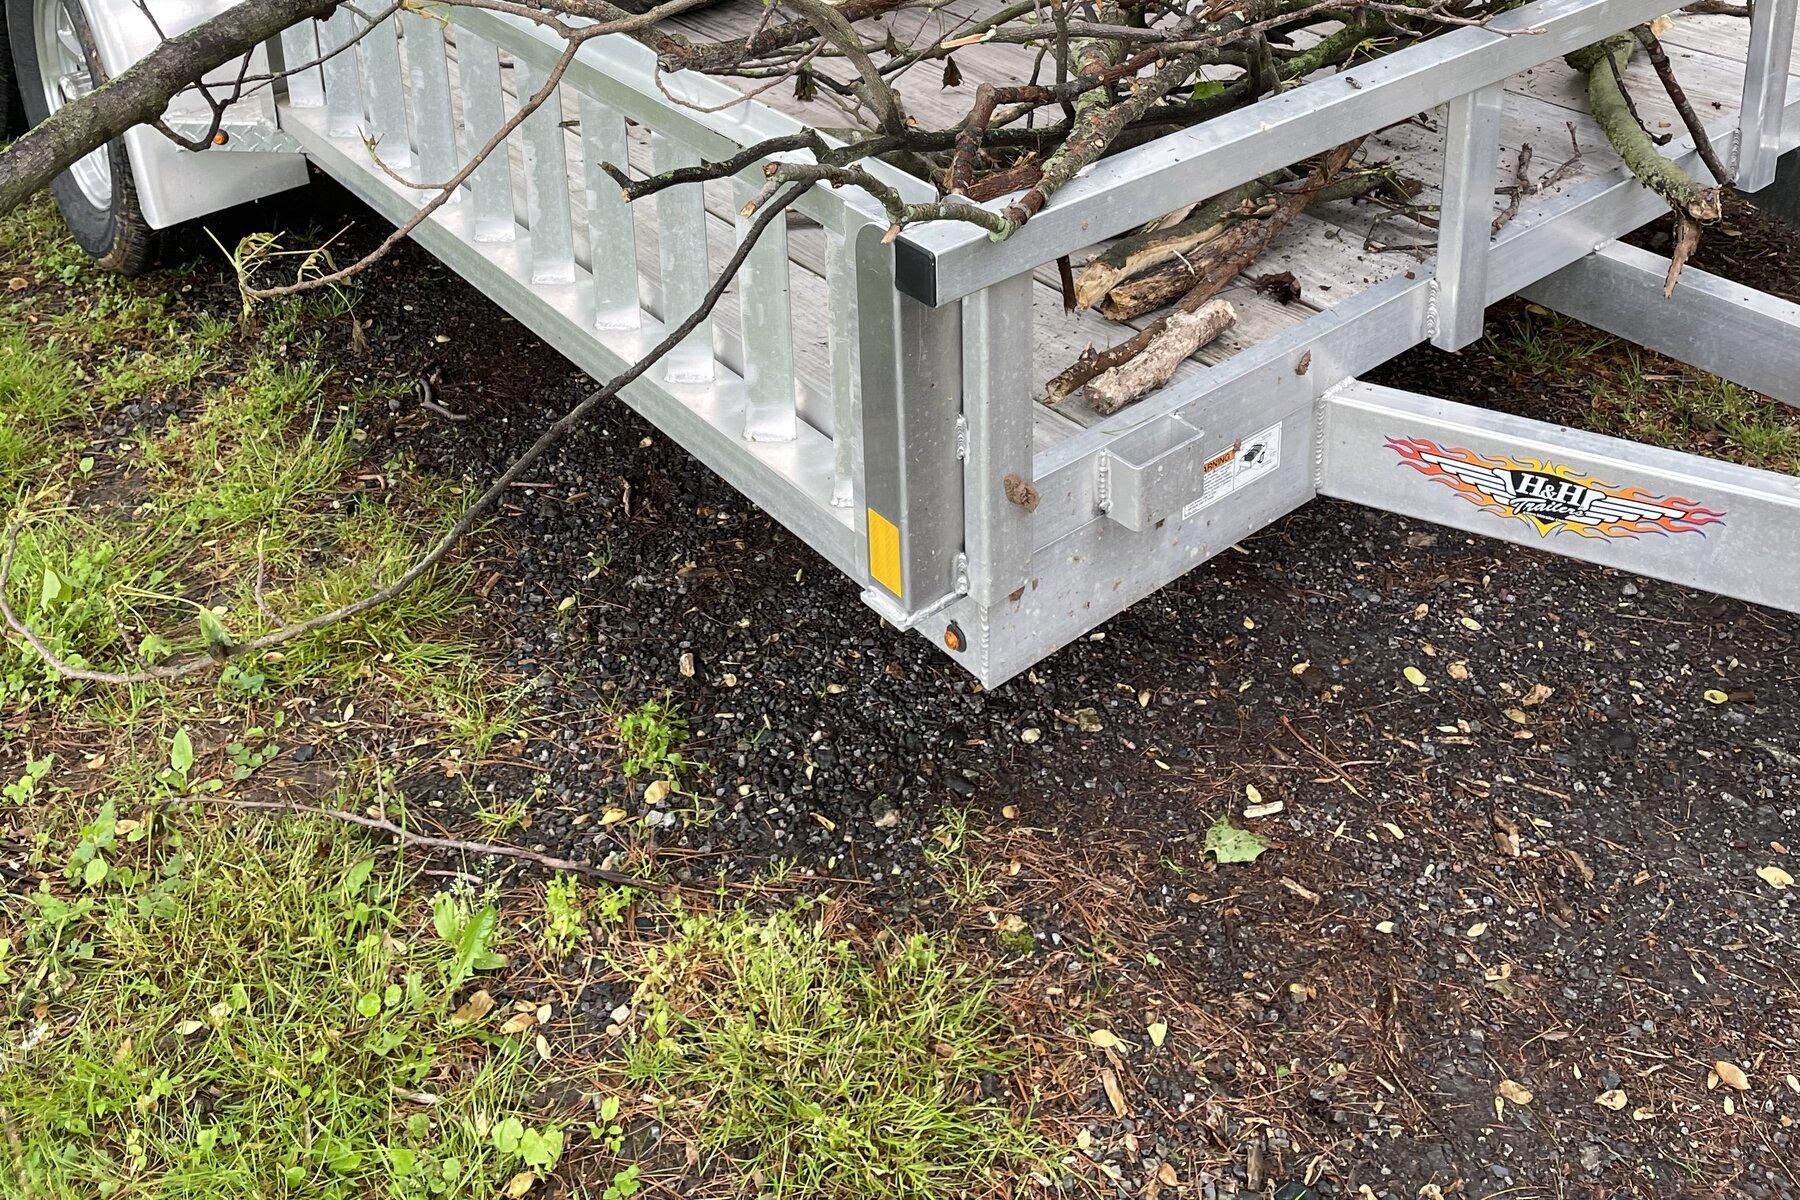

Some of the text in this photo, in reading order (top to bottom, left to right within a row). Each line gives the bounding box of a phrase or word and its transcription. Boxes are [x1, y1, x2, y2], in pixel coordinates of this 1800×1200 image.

[1203, 452, 1231, 473] ARNING
[1515, 472, 1587, 506] H&H
[1510, 498, 1584, 517] Trailers
